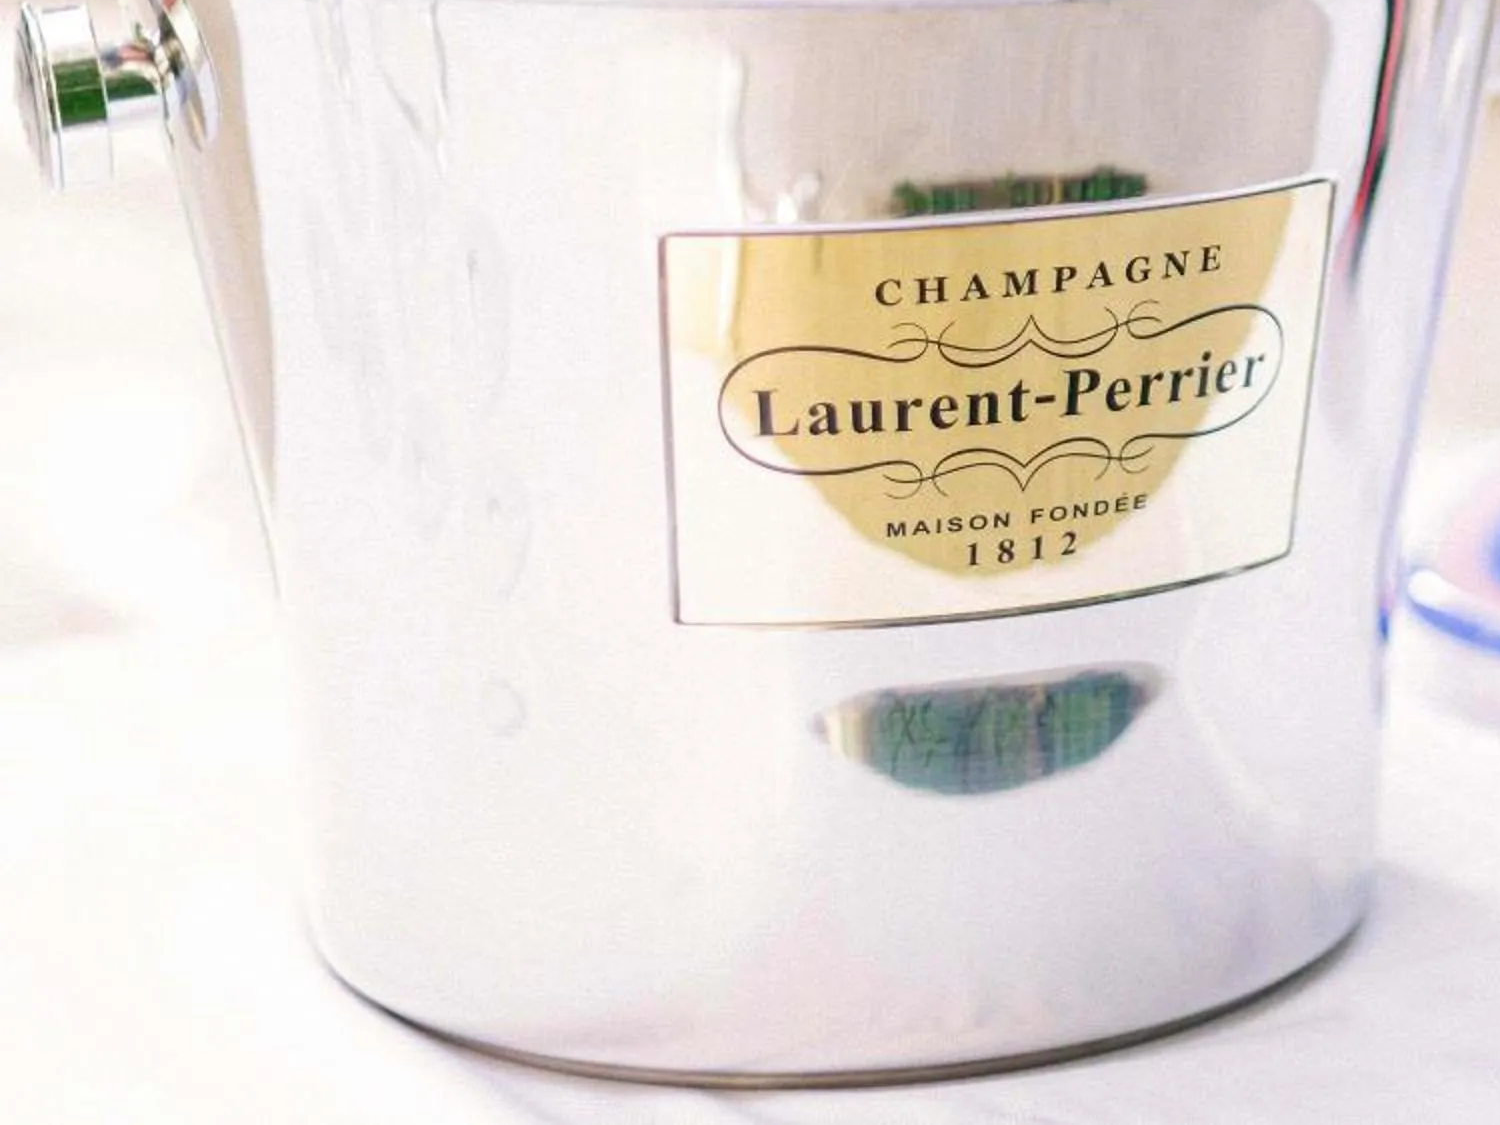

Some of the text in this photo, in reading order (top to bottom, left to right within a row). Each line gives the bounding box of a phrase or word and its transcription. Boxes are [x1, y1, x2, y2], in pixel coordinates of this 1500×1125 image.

[874, 244, 1222, 307] CHAMPAGNE
[752, 349, 1266, 438] Laurent-Perrier
[886, 492, 1149, 538] MAISON FONDÉE
[966, 531, 1078, 567] 1812
